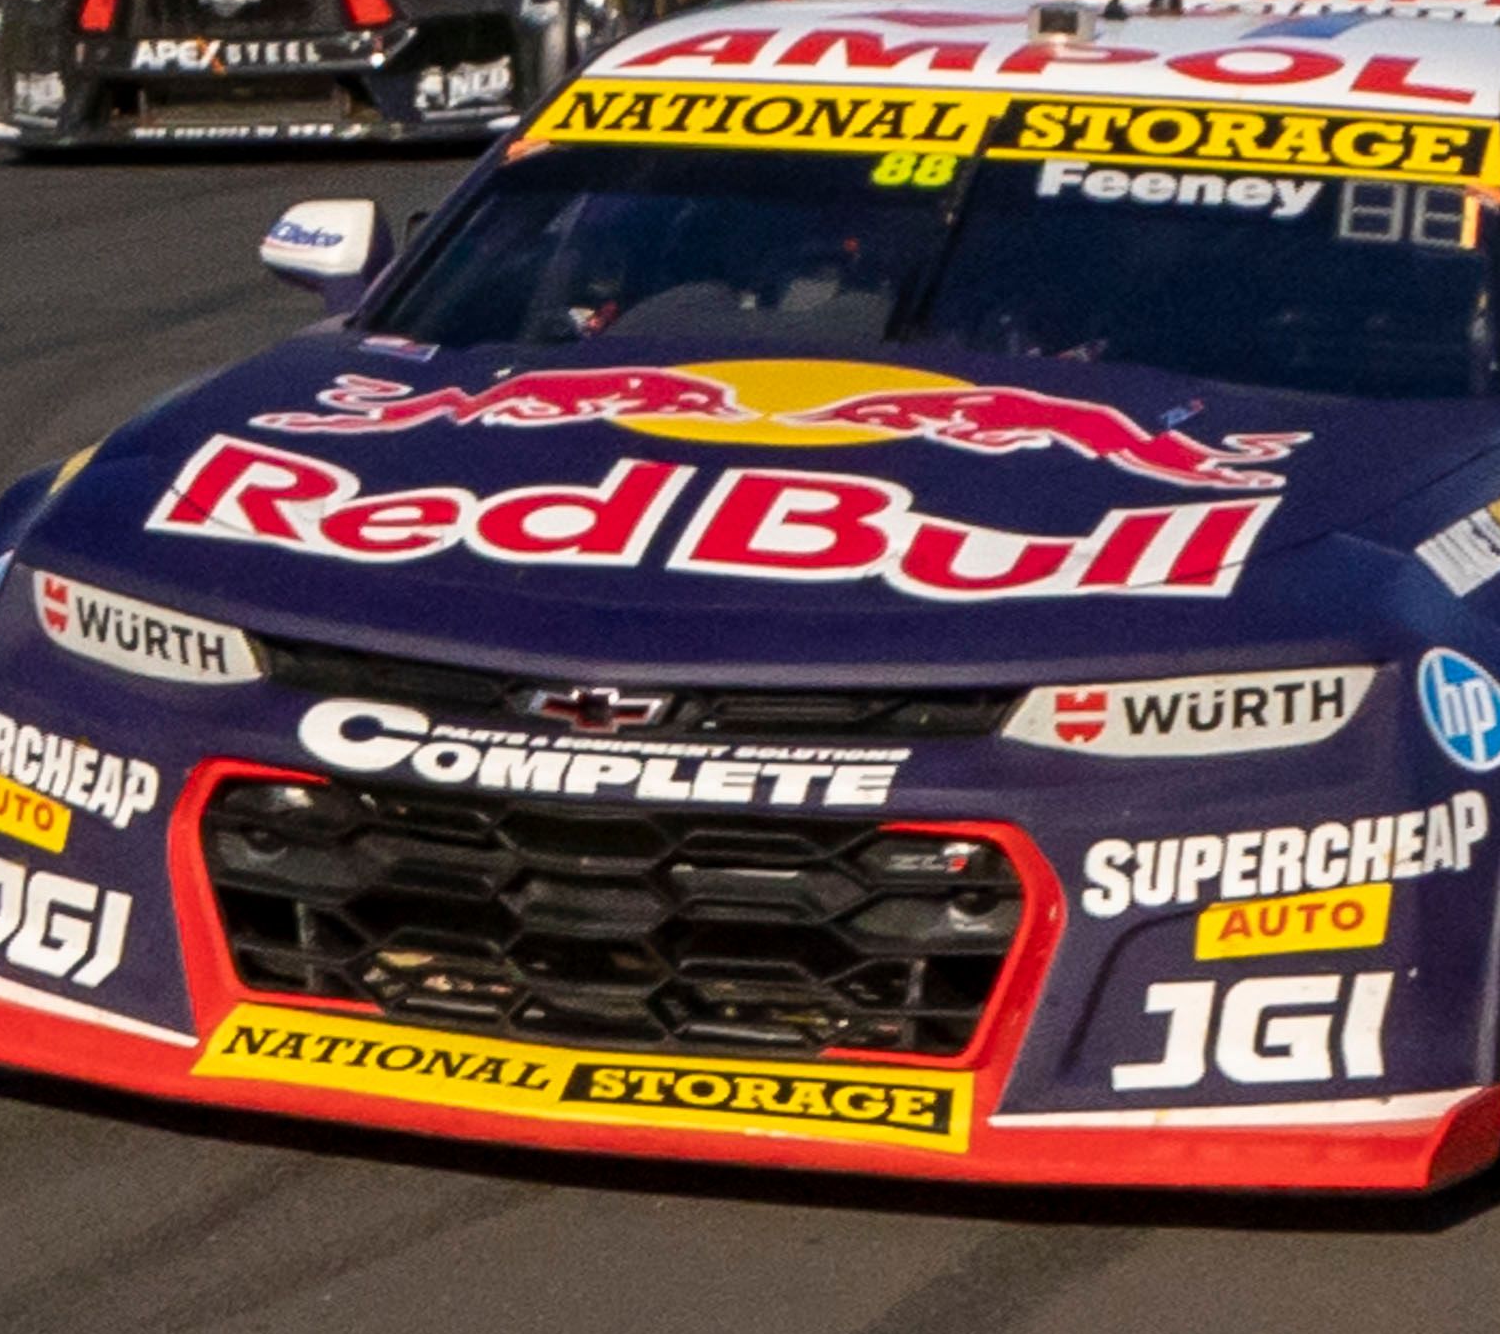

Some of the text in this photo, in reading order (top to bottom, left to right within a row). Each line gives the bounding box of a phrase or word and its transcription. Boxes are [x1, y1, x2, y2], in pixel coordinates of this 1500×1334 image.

[615, 27, 1478, 107] AMPOL
[552, 91, 1470, 173] NATIONAL STORAGE
[871, 150, 1324, 220] 88 Feeney
[145, 433, 688, 570] Red
[666, 464, 1282, 601] Bull
[76, 595, 230, 674] WÜRTH
[431, 724, 527, 747] PARTS
[553, 734, 731, 760] EQUIPMENT
[733, 744, 914, 764] SOLUTIONS
[1121, 675, 1347, 736] WÜRTH
[297, 696, 900, 807] COMPLETE
[1082, 789, 1492, 920] SUPERCHEAP
[1216, 897, 1368, 940] AUTO
[1111, 970, 1396, 1092] JGI
[220, 1022, 940, 1128] NATIONAL STORAGE
